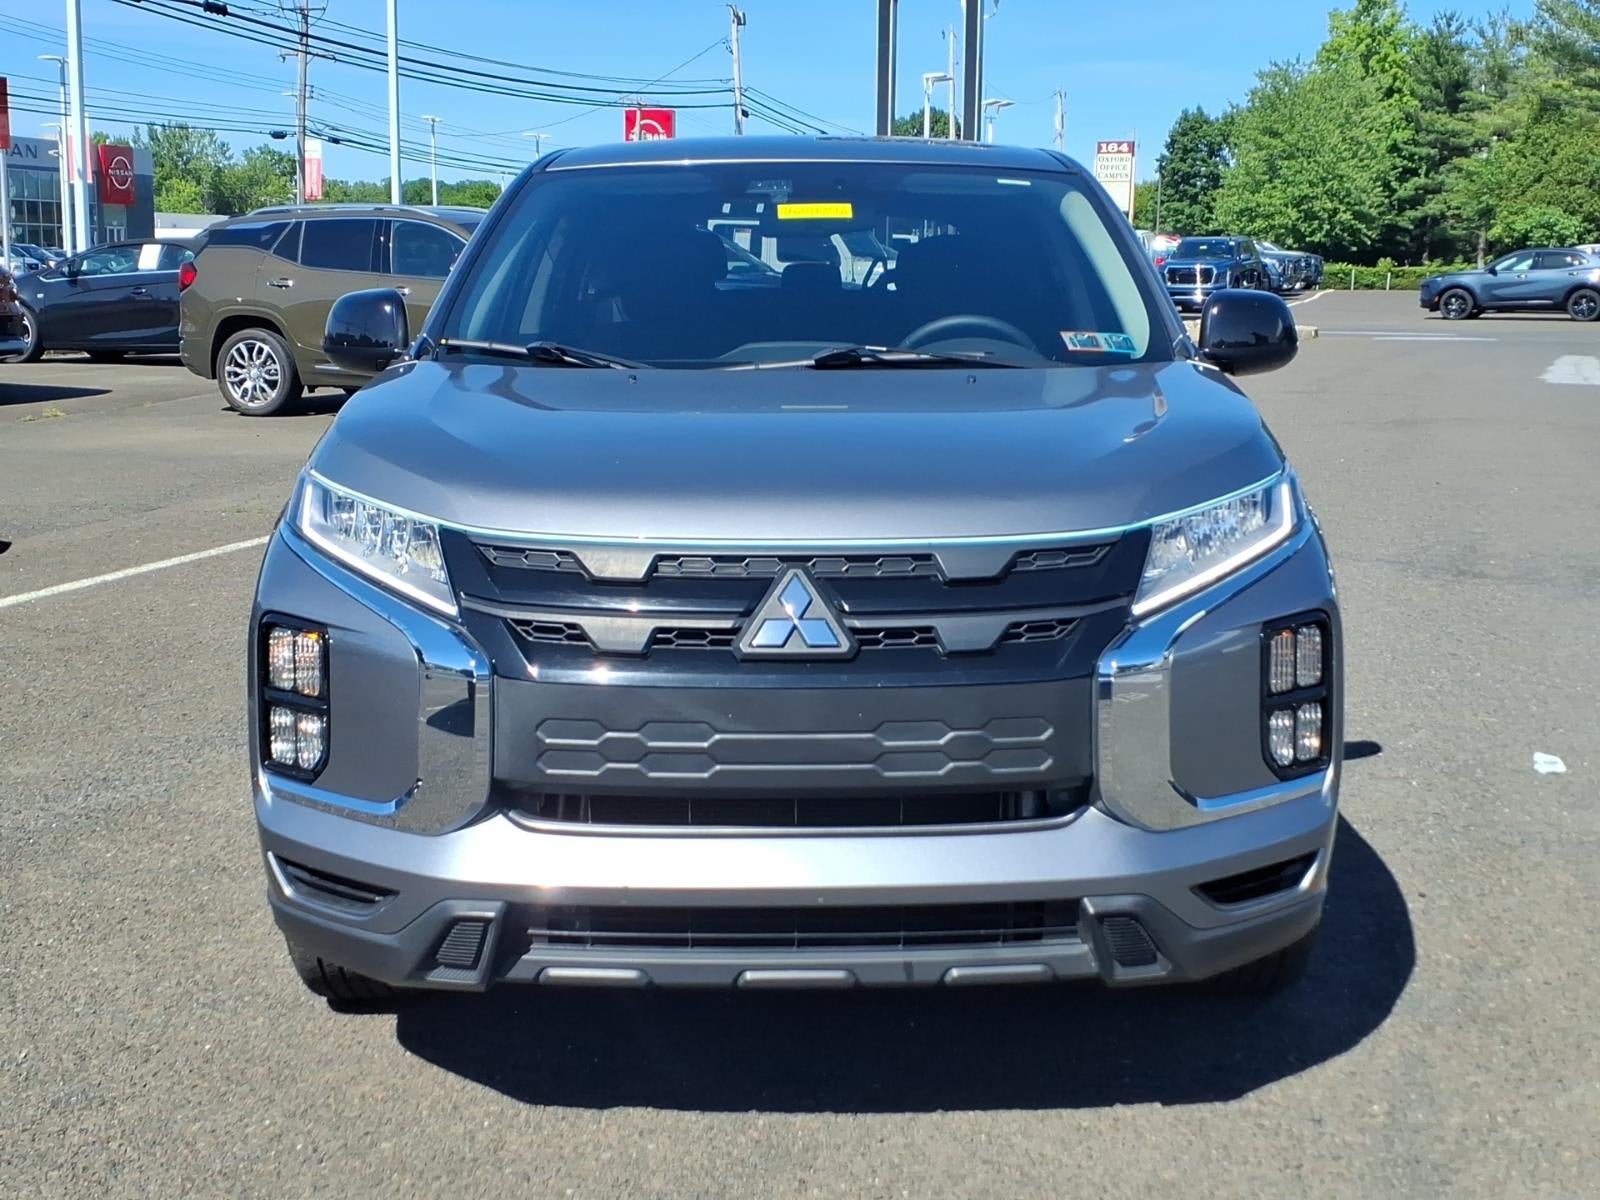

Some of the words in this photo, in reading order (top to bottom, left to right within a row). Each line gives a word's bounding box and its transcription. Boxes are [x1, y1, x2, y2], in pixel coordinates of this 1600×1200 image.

[6, 143, 38, 158] AN
[1100, 142, 1129, 153] 164
[108, 168, 133, 176] NISSAN
